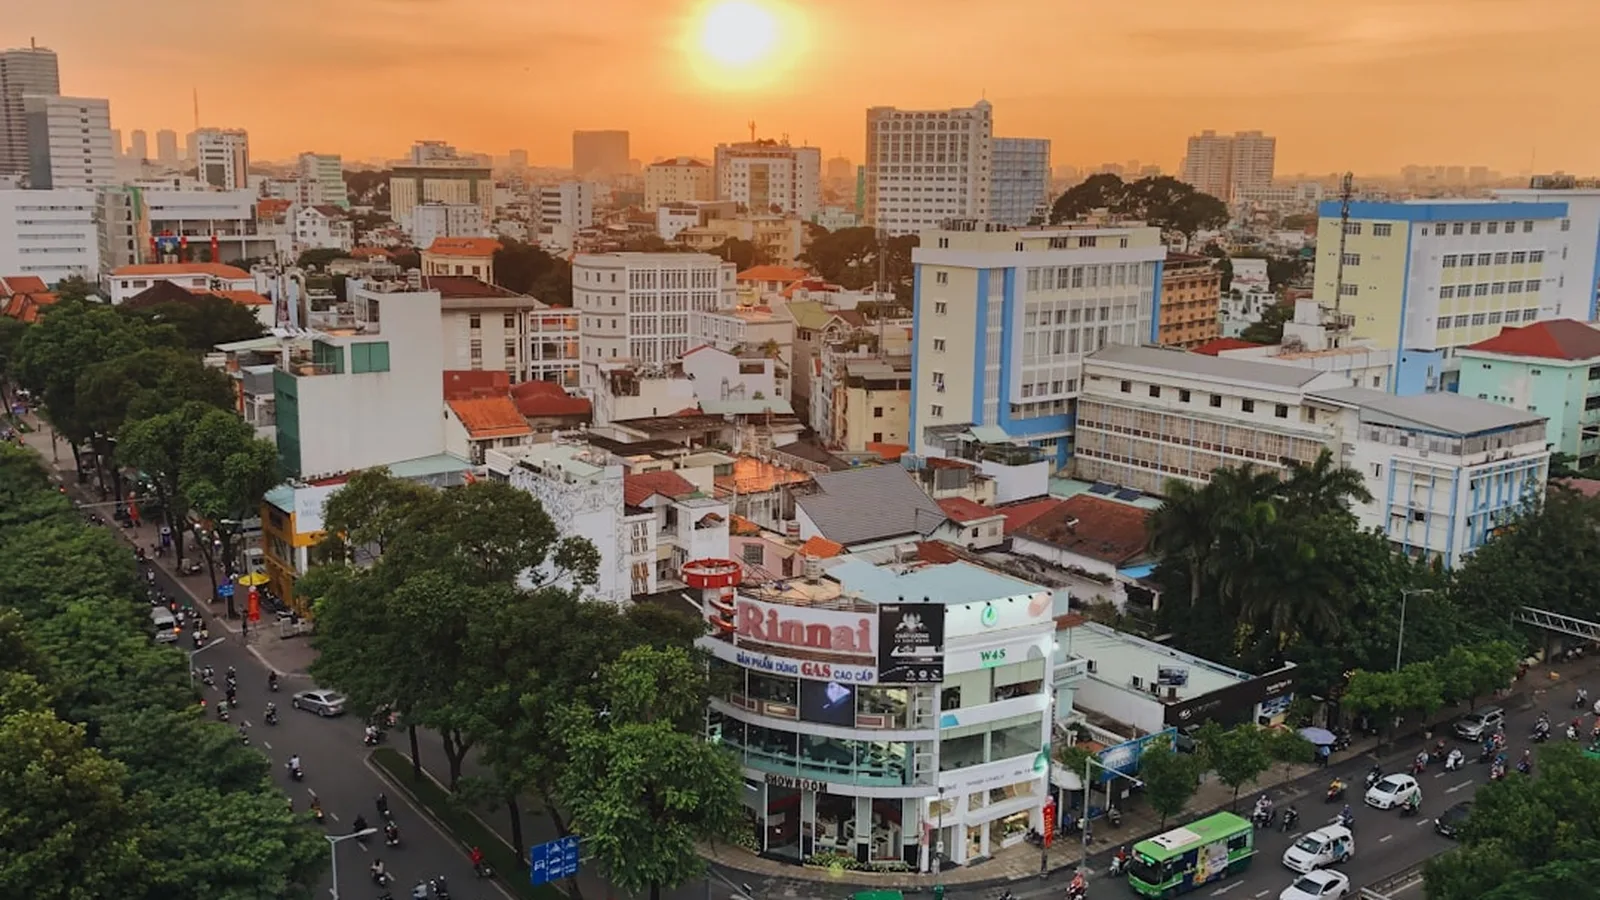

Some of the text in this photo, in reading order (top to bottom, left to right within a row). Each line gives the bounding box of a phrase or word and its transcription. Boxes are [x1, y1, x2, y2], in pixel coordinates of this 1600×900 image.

[737, 601, 872, 652] Rinnai
[752, 655, 773, 670] PHẨM
[775, 660, 799, 675] DÙNG
[801, 662, 831, 679] GAS
[833, 670, 853, 681] CAO
[854, 668, 874, 682] CẤP
[764, 773, 828, 793] SHOWROOM
